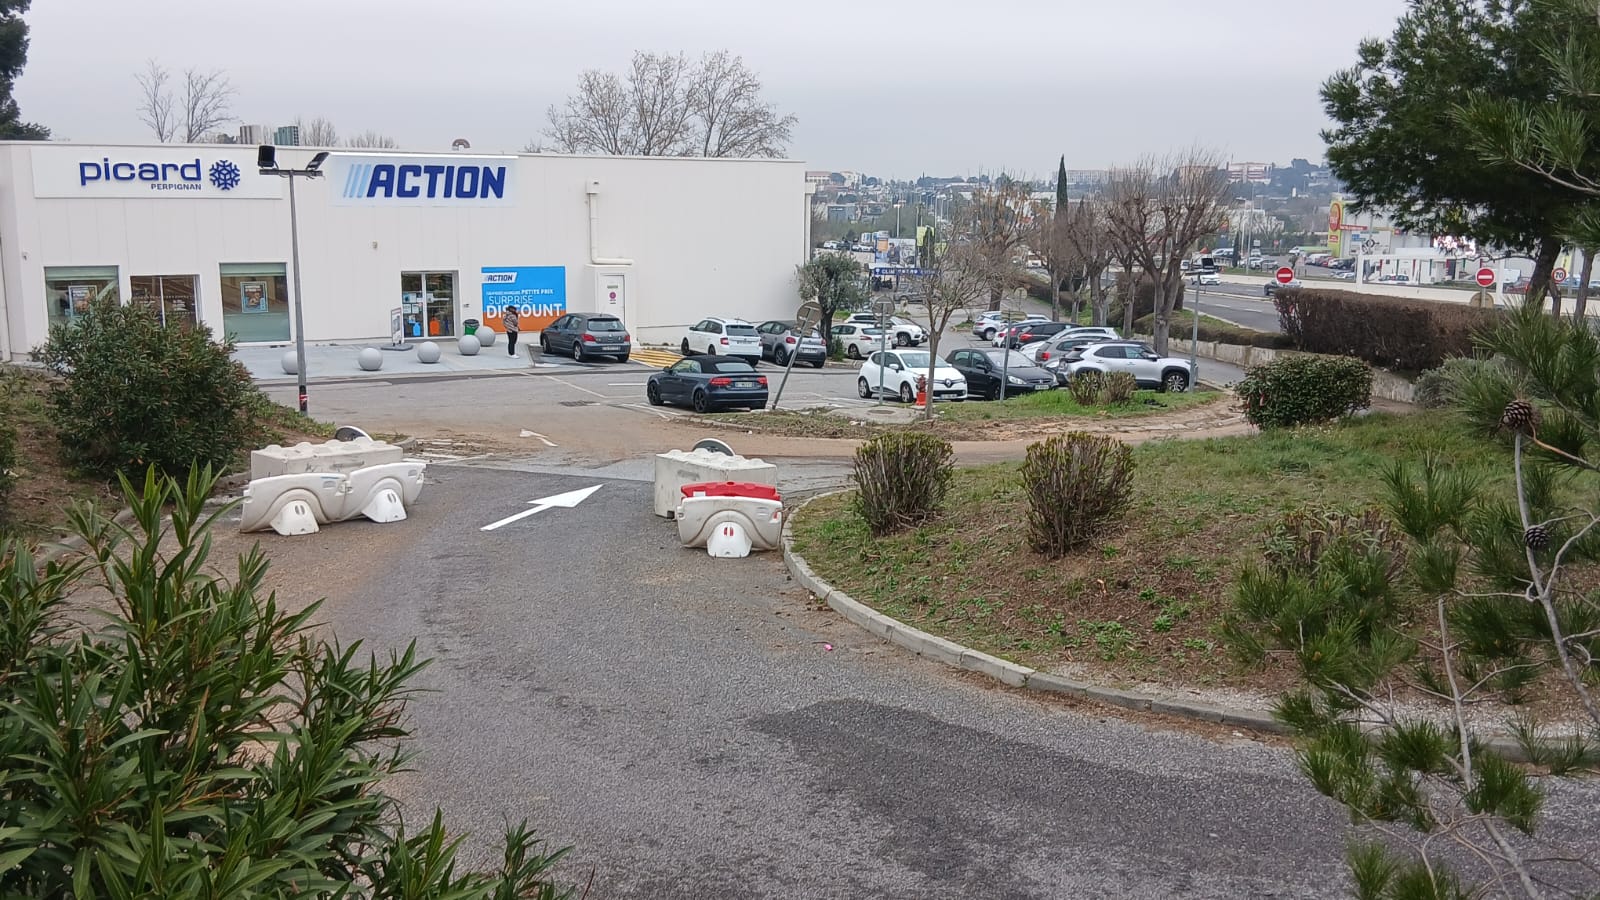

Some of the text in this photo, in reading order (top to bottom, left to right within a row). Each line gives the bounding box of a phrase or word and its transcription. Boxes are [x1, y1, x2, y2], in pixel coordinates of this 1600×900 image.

[79, 157, 202, 186] picard
[366, 164, 506, 199] ACTION
[487, 274, 513, 282] ACTION
[488, 295, 533, 305] SURPRISE
